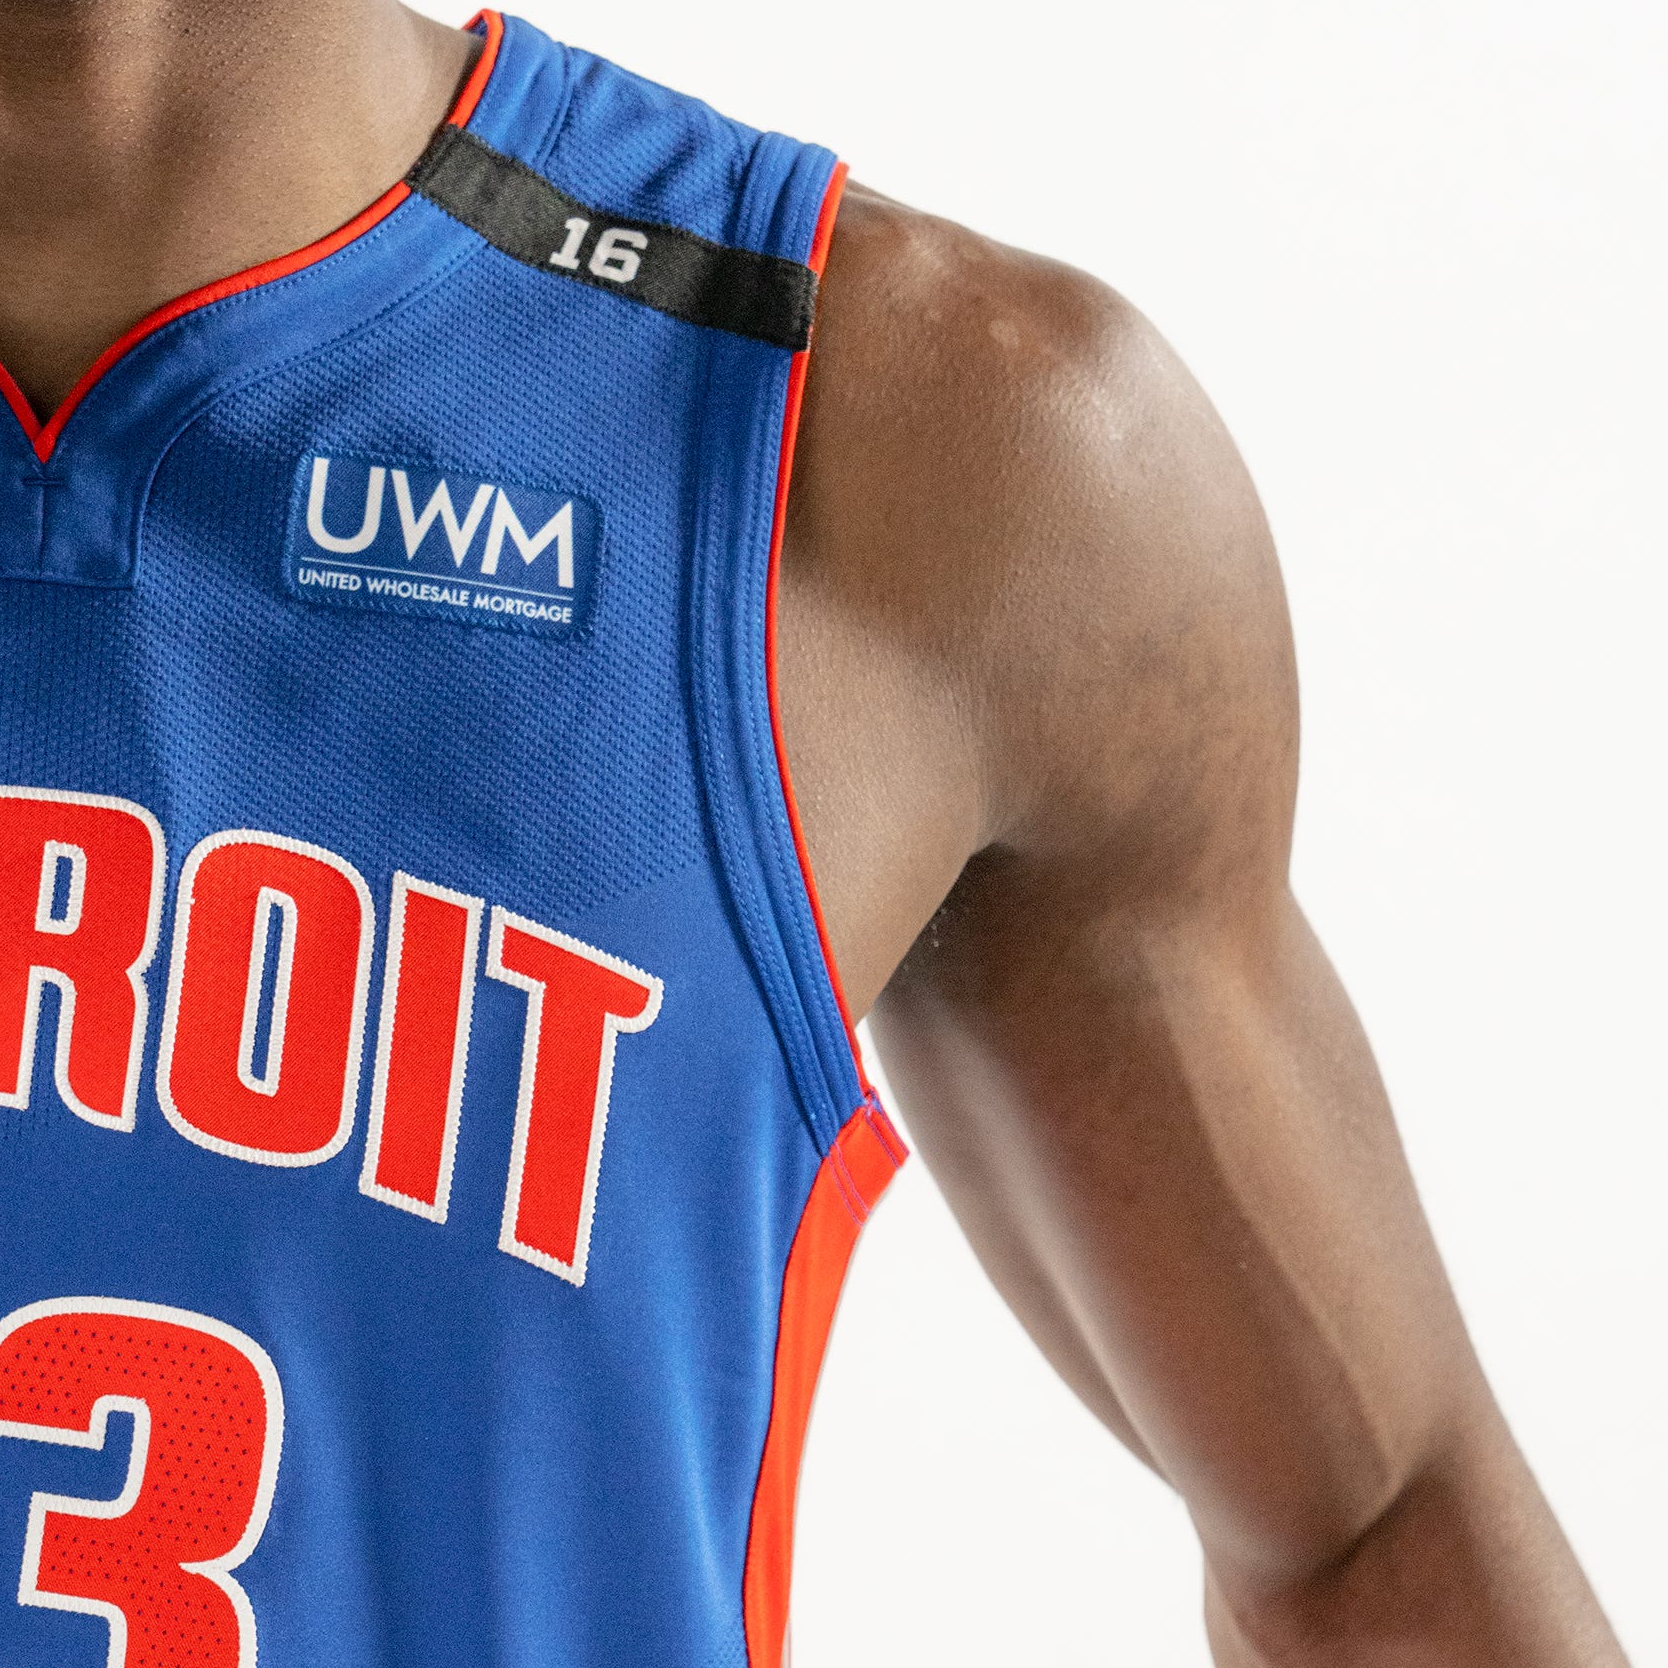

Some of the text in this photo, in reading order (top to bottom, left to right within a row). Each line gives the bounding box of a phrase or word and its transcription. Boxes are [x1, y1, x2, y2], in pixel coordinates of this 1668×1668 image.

[549, 217, 649, 284] 16
[306, 456, 575, 589] UWM
[298, 567, 573, 624] UNITED WHOLESALE MORTGAGE
